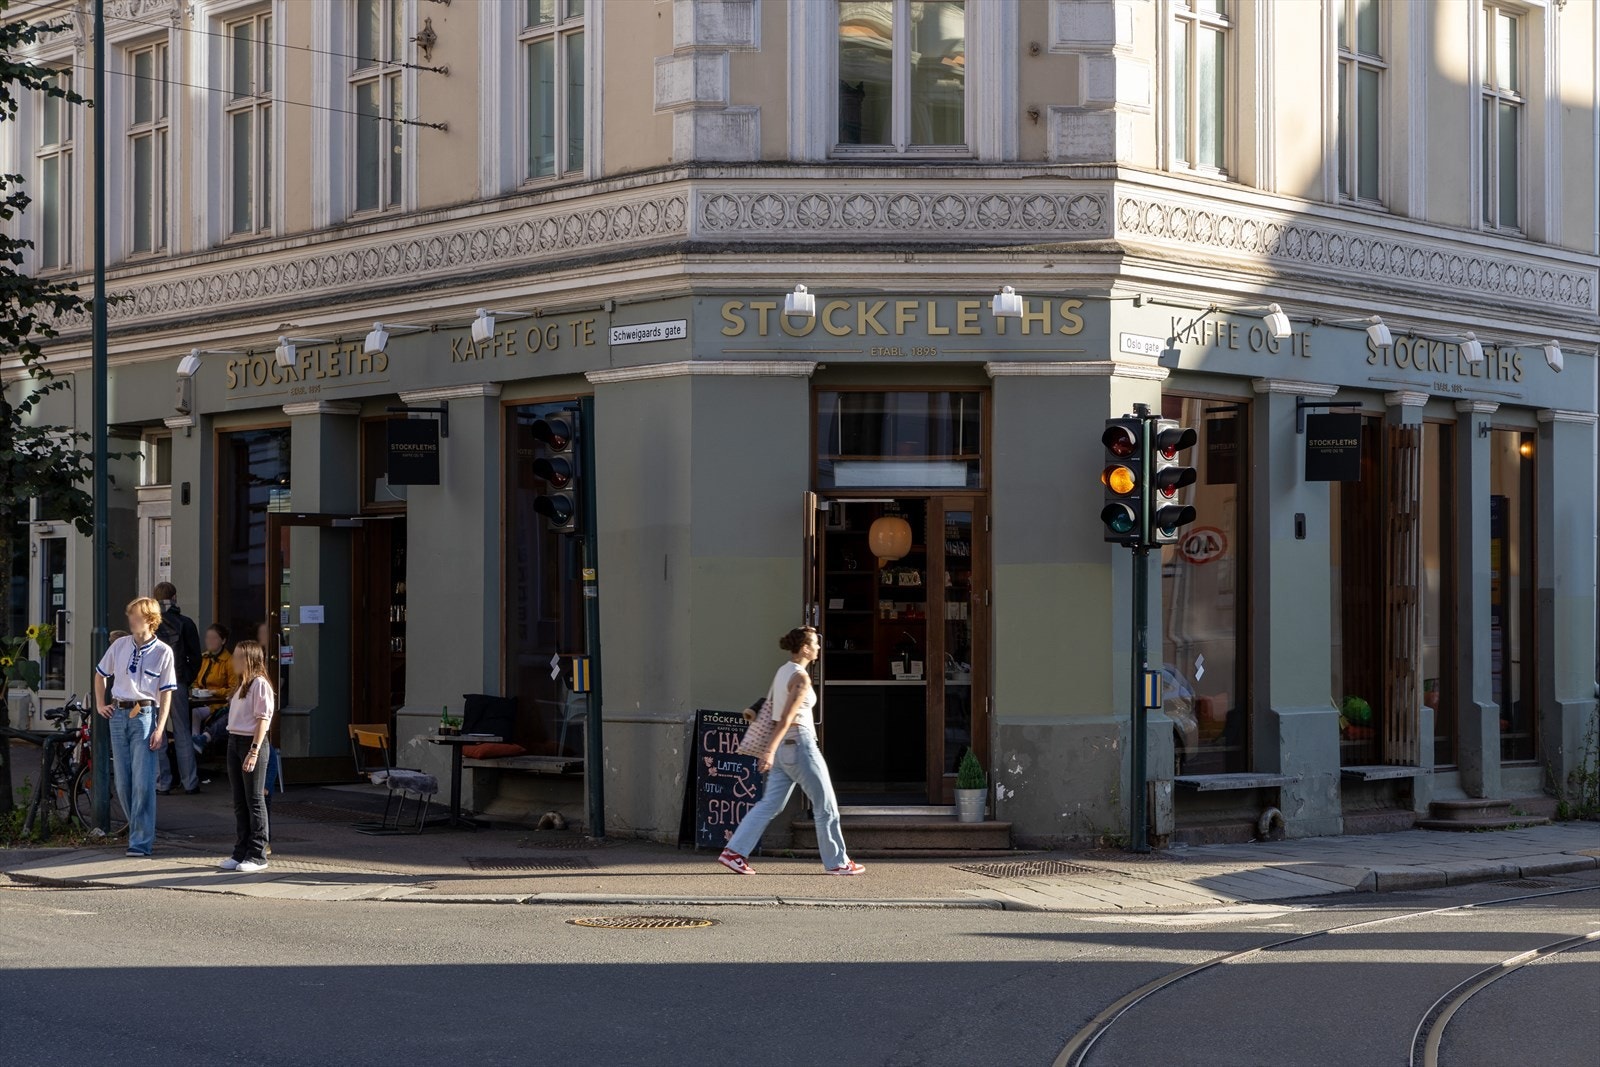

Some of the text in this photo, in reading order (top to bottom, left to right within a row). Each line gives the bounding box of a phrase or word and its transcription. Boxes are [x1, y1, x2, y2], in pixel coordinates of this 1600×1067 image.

[720, 299, 1084, 337] STOCKFLETHS
[525, 323, 560, 354] OG
[569, 318, 596, 347] TE
[613, 325, 681, 342] Schweigaards gate
[1171, 316, 1312, 358] KAFFE OG TE
[870, 346, 937, 356] ETABL. 1895
[1126, 337, 1159, 354] Oslo gate
[391, 443, 436, 451] STOCKFLETHS
[1309, 438, 1358, 446] STOCKFLETHS
[717, 760, 742, 772] LATTE
